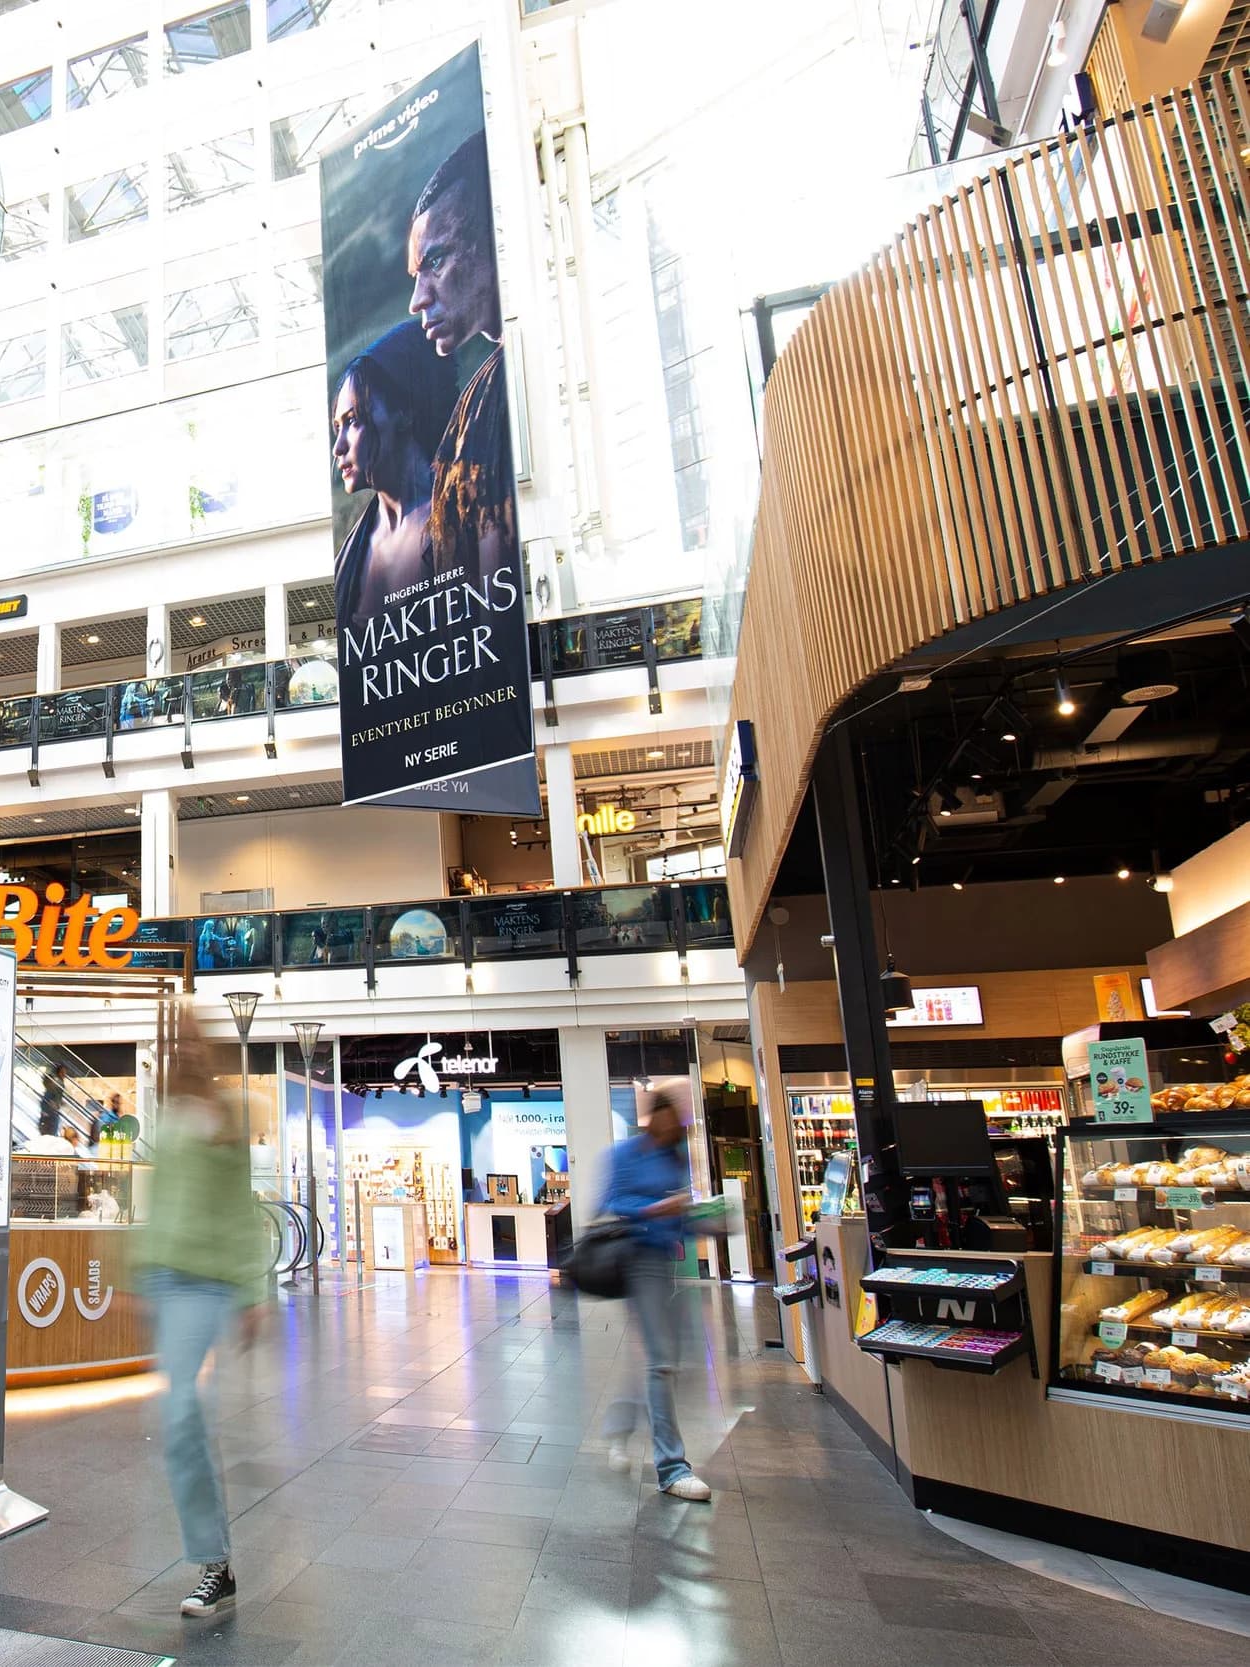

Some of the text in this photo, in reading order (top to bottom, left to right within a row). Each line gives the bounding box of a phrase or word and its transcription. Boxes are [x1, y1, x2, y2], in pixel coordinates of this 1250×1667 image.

[353, 89, 439, 160] prime video
[384, 566, 465, 605] RINGENES HERRE
[343, 566, 518, 666] MAKTENS
[301, 631, 308, 640] &
[362, 625, 501, 706] RINGER
[352, 685, 517, 747] EVENTYRET BEGYNNER
[404, 741, 459, 768] NY SERIE
[577, 804, 636, 835] nille
[440, 1055, 498, 1074] telenor
[1093, 1049, 1140, 1060] RUNDSTYKKE
[1109, 1057, 1131, 1066] KAFFE
[515, 1114, 548, 1124] 1.000,-
[29, 1273, 57, 1313] WRAPS
[88, 1260, 101, 1305] SALADS
